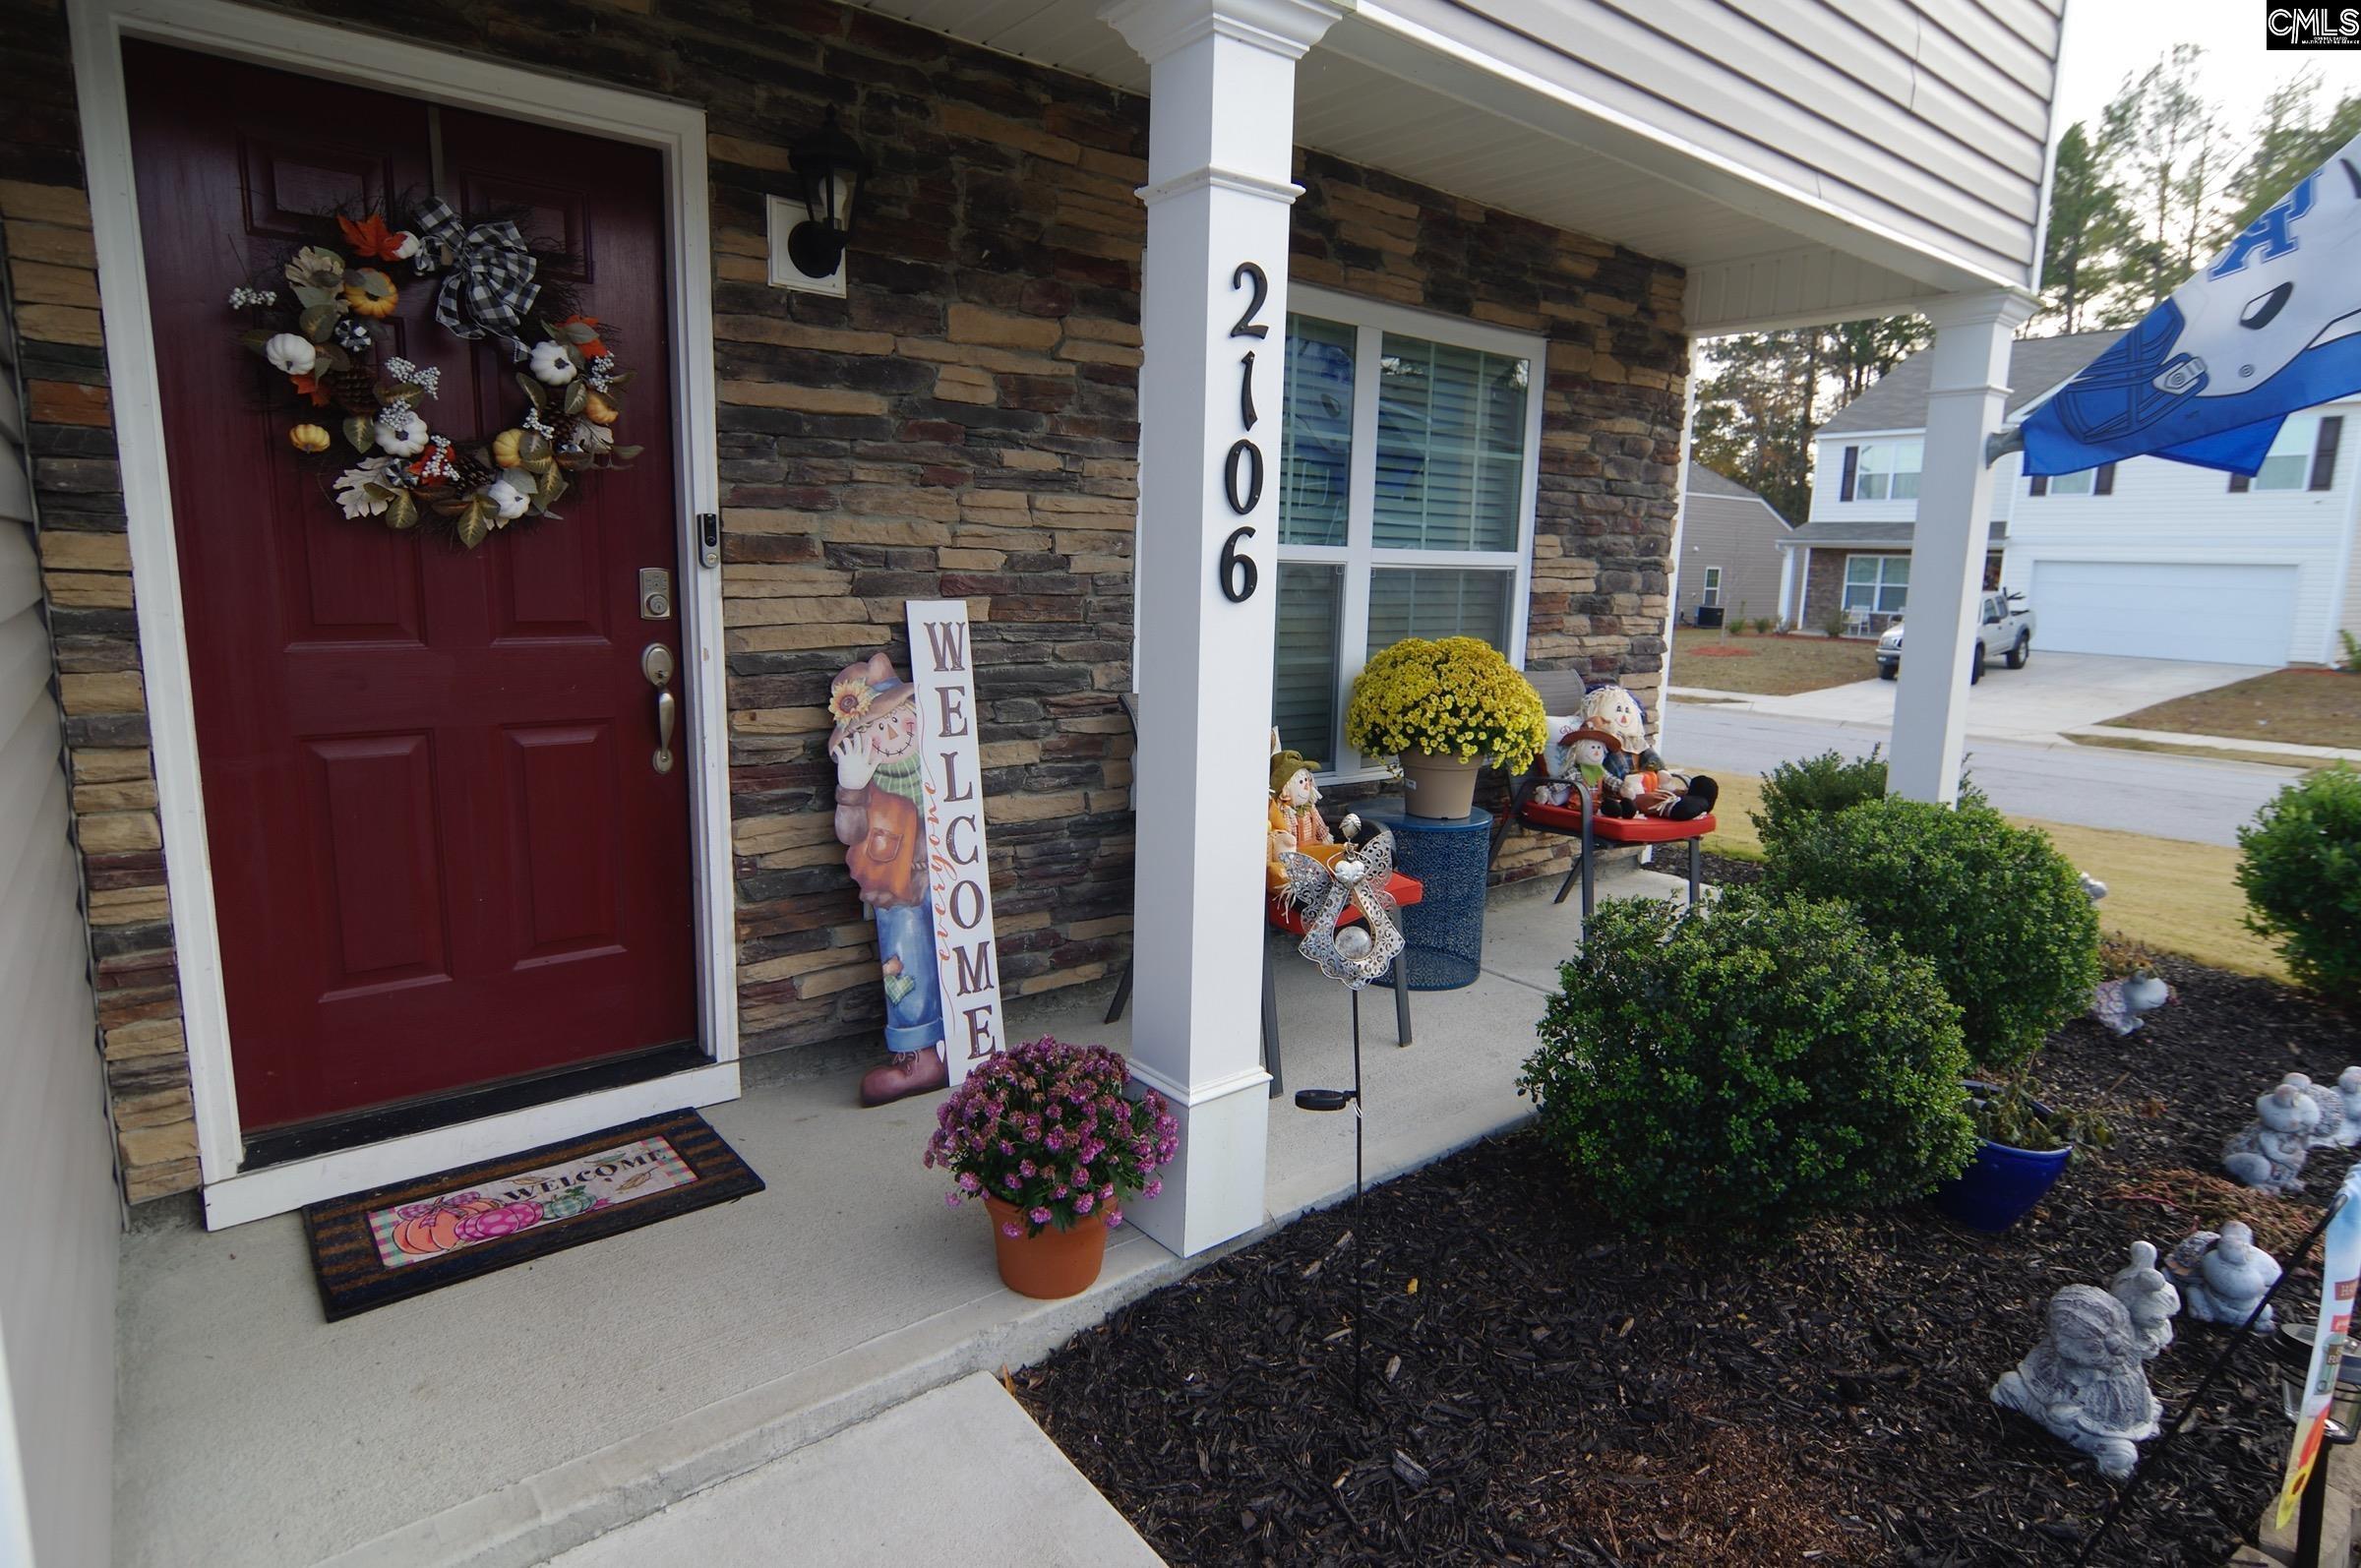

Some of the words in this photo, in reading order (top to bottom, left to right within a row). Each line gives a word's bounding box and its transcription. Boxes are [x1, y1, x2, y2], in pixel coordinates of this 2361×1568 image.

[1220, 262, 1268, 602] 2106
[923, 780, 958, 962] everyone
[924, 621, 996, 1061] WELCOME
[504, 1148, 667, 1201] WELCOME
